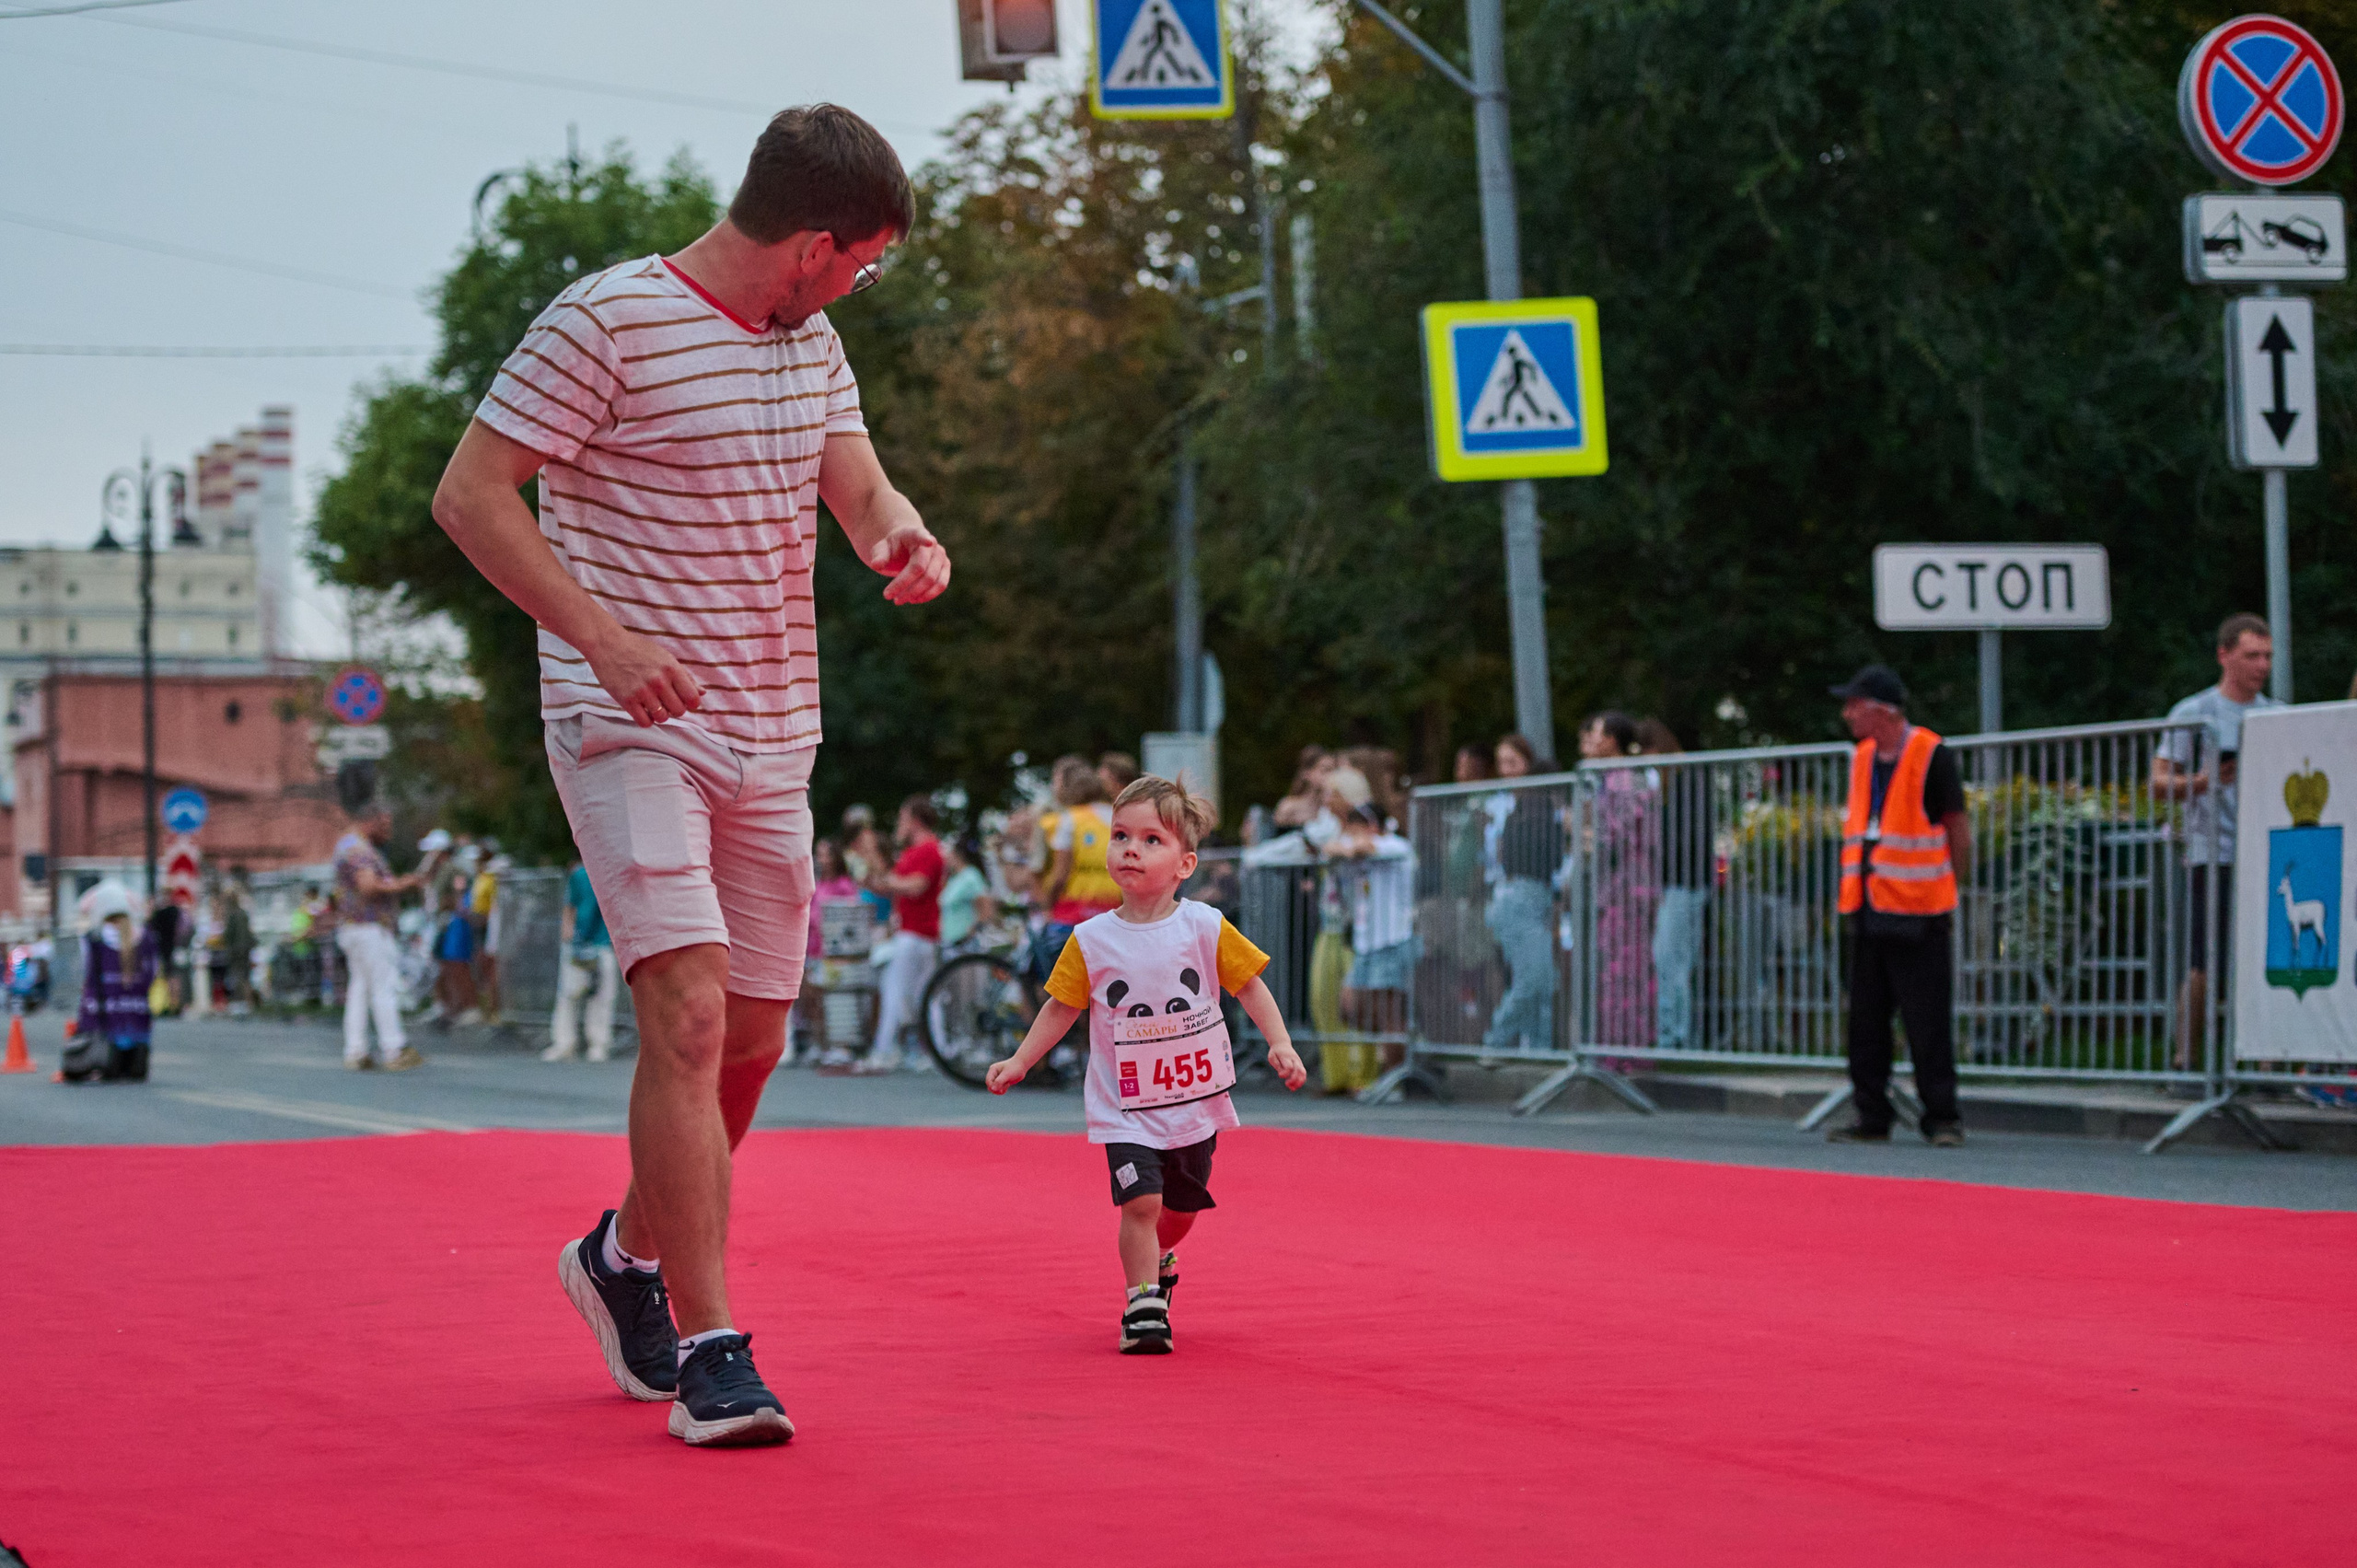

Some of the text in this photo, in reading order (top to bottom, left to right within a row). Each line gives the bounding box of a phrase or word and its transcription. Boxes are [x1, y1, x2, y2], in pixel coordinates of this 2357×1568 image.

[1912, 563, 2075, 611] СТОП
[1183, 1006, 1212, 1023] НОЧНОЙ
[1127, 1025, 1177, 1038] САМАРЫ
[1184, 1017, 1209, 1031] ЗАБЕГ
[1154, 1049, 1212, 1090] 455
